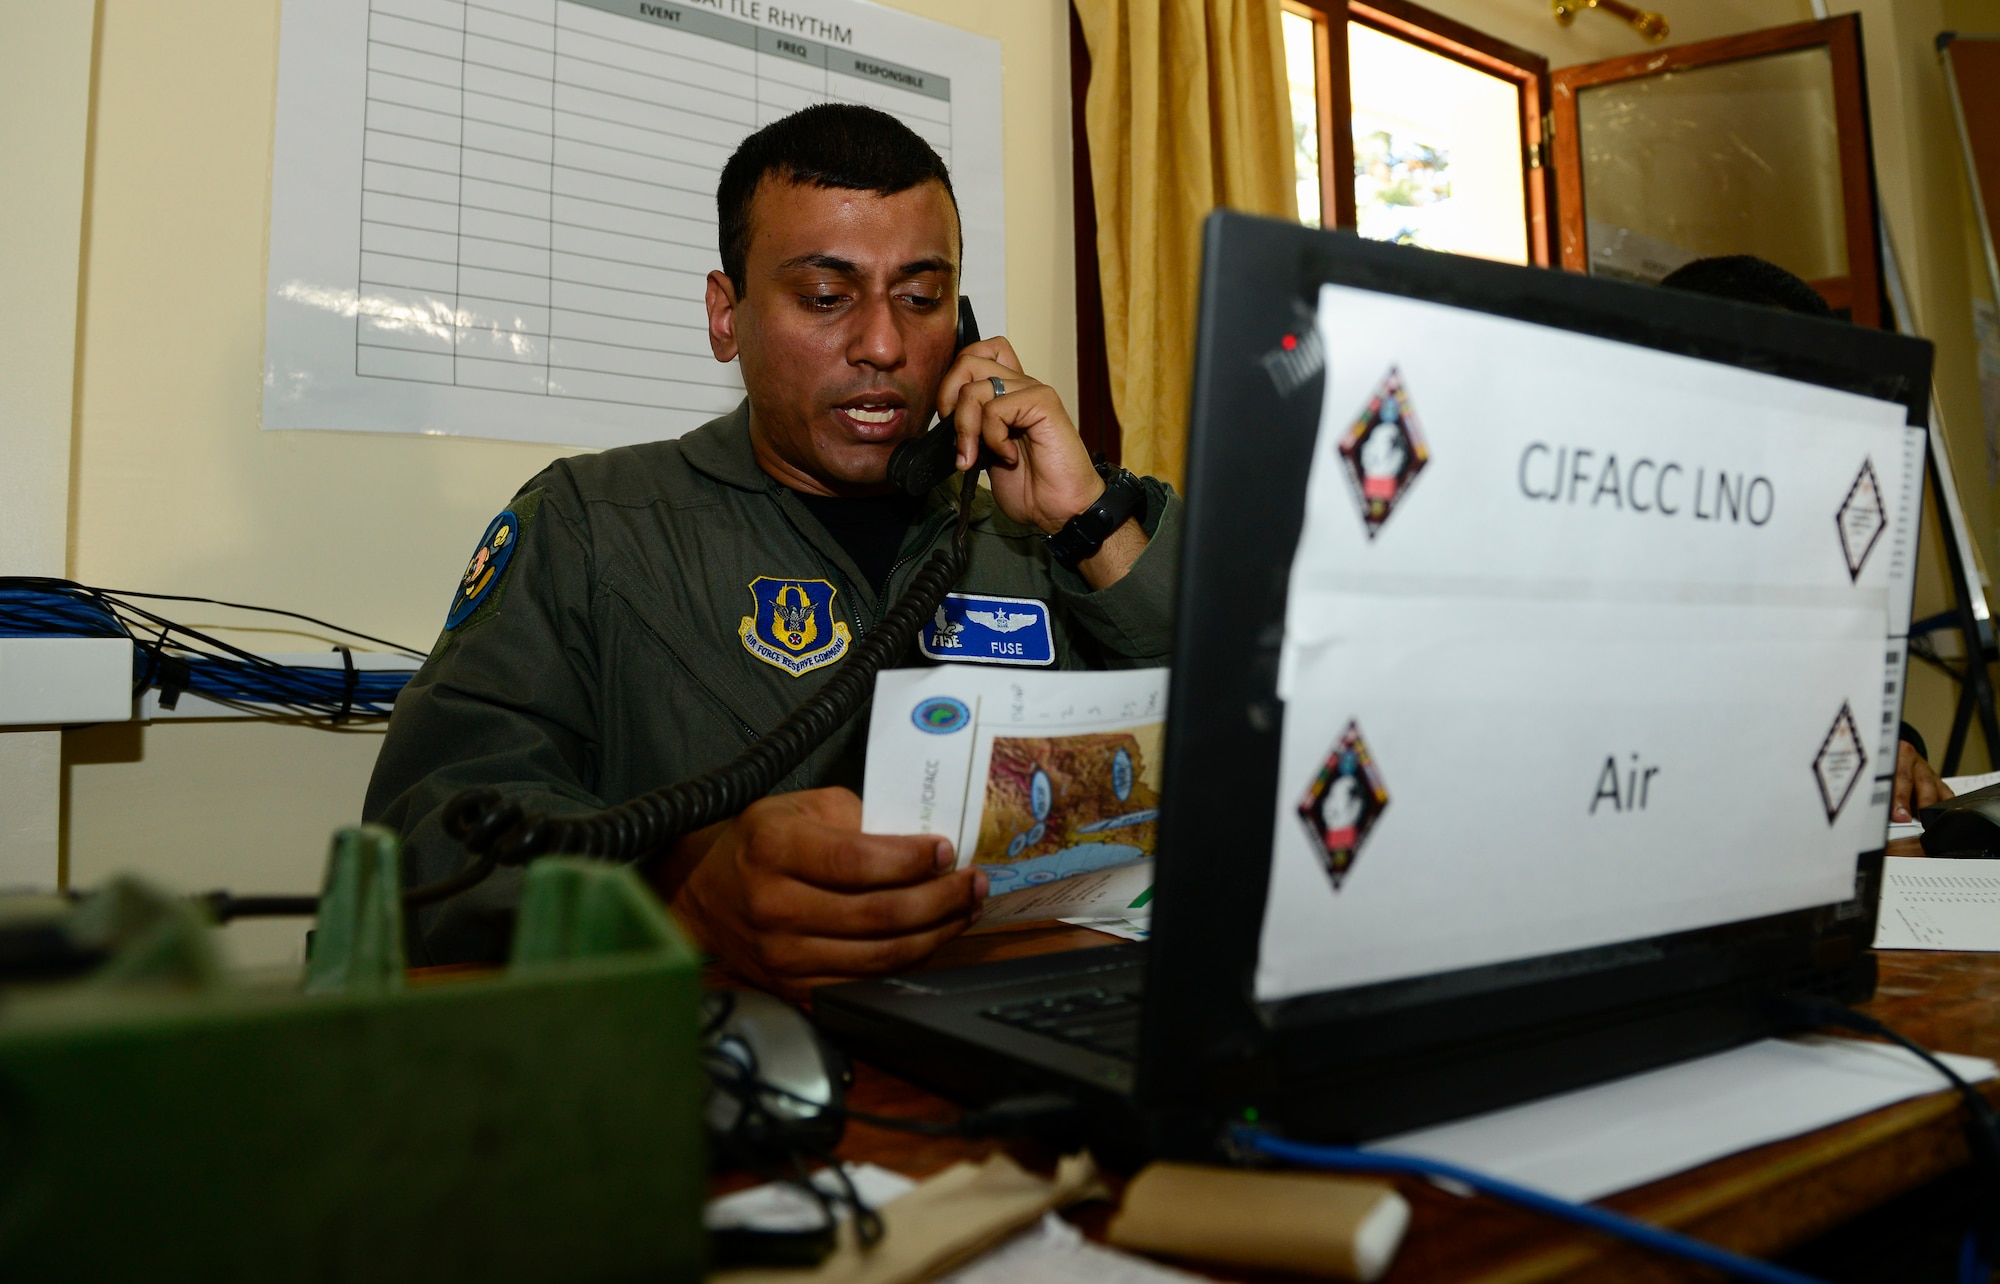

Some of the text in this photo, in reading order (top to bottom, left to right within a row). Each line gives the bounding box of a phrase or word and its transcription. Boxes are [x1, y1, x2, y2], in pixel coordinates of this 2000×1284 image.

[640, 3, 924, 88] EVENT FREQ RESPONSIBLE
[767, 6, 853, 45] RHYTHM
[1517, 441, 1684, 516] CJFACC
[1694, 467, 1775, 527] LNO
[745, 634, 846, 672] AIR FORCE RESERVE COMMAND
[990, 641, 1024, 655] FUSE
[1587, 752, 1660, 816] Air
